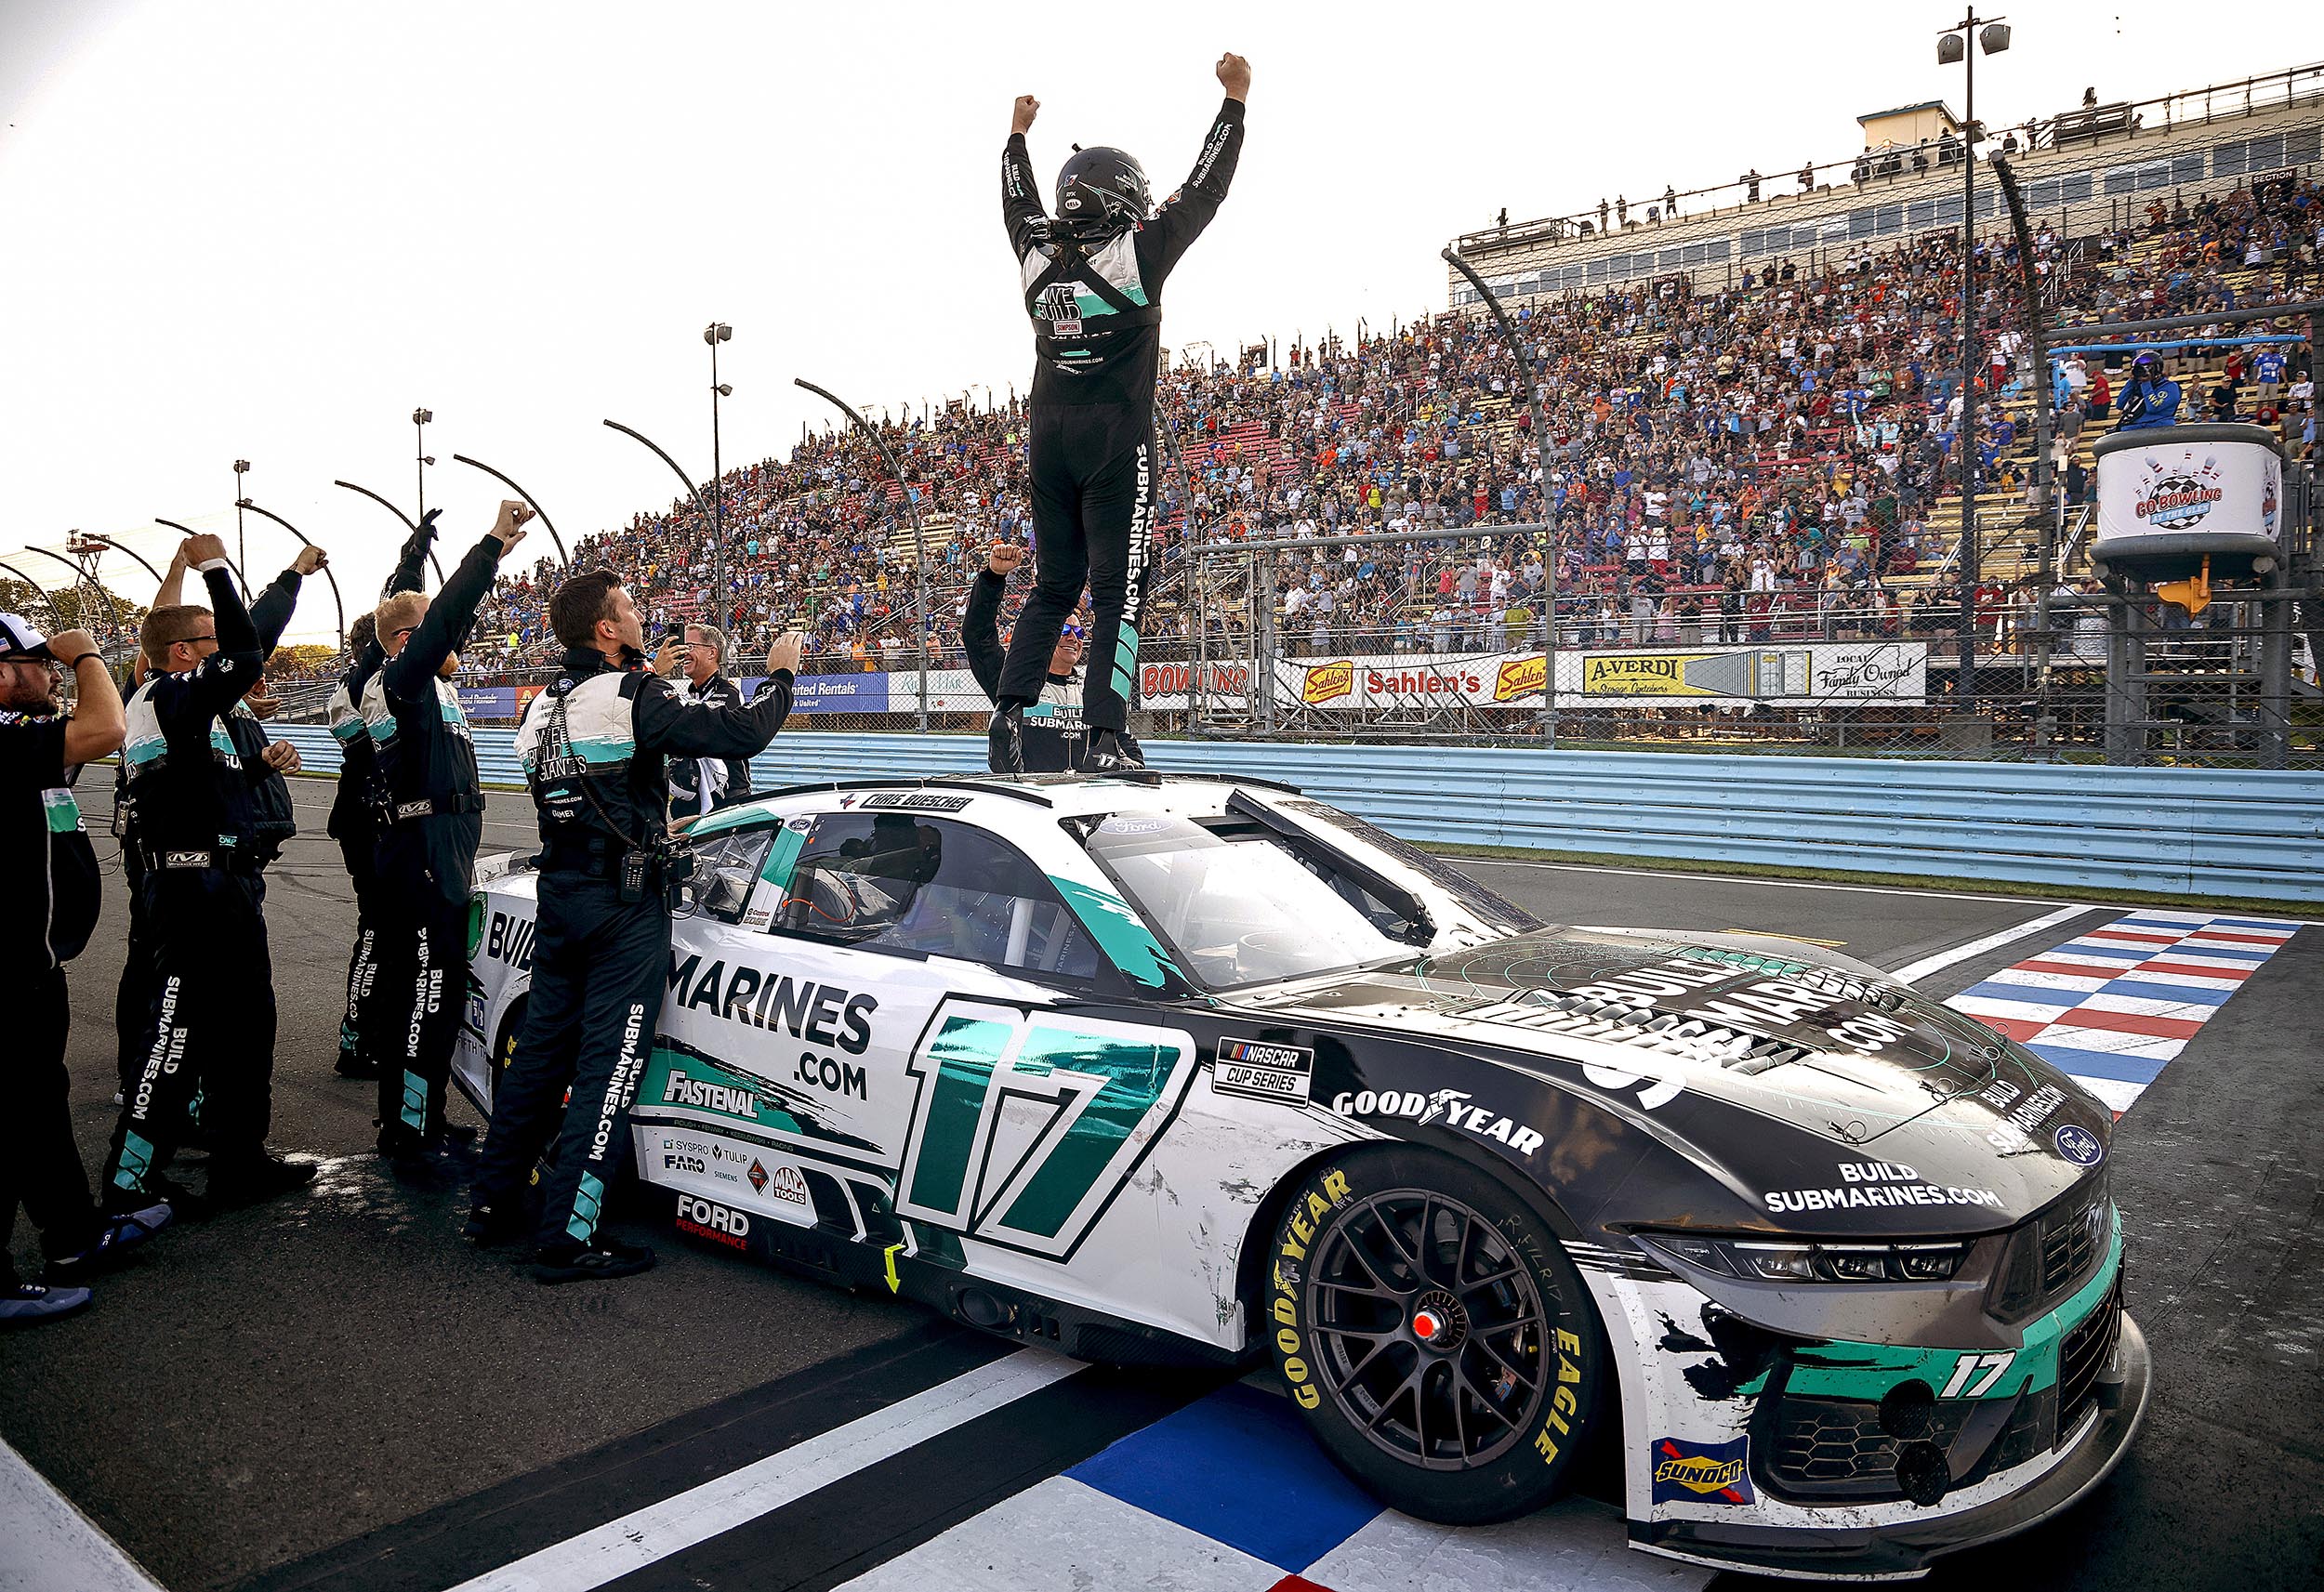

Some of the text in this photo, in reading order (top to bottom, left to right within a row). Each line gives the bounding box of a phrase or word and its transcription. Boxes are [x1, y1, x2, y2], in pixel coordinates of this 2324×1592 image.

[2253, 170, 2293, 184] SECTION
[1066, 200, 1080, 209] BELL
[1923, 227, 1956, 239] SECTION
[1045, 286, 1075, 305] WE
[1037, 302, 1081, 321] BUILD
[1056, 322, 1079, 332] SIMPSON
[2135, 488, 2223, 519] GO BOWLING
[1121, 443, 1149, 622] SUBMARINES.COM
[1591, 659, 1678, 682] A-VERDI
[1837, 654, 1868, 664] LOCAL
[1307, 669, 1350, 694] Sahlen's
[1367, 671, 1481, 694] Sahlen's
[1817, 658, 1912, 690] Family Owned
[792, 681, 857, 696] nited Rentals
[1029, 716, 1094, 730] SUBMARI
[1100, 753, 1116, 768] 17
[865, 793, 974, 811] CHRIS BUESCHER
[1114, 820, 1162, 833] Ford
[752, 909, 771, 917] Castrol
[487, 910, 536, 972] BUIL
[350, 929, 375, 1021] SUBMARINES.CO
[361, 963, 377, 997] BUILD
[428, 969, 443, 1013] BUILD
[667, 948, 879, 1056] MARINES
[132, 975, 181, 1120] SUBMARINES.COM
[164, 1027, 188, 1074] BUILD
[1246, 1046, 1300, 1068] NASCAR
[588, 1003, 644, 1162] SUBMARINES.COM
[793, 1051, 868, 1102] .COM
[1226, 1067, 1297, 1091] CUP SERIES
[663, 1069, 759, 1119] FASTENAL
[1978, 1079, 2022, 1110] BUILD
[673, 1119, 697, 1128] ROUSH
[701, 1124, 724, 1134] FENWAY
[771, 1140, 794, 1152] RACING
[895, 992, 1198, 1266] 17
[1332, 1088, 1546, 1157] GOODYEAR
[676, 1140, 708, 1155] SYSPRO
[723, 1150, 748, 1164] TULIP
[2059, 1129, 2097, 1162] Ford
[664, 1154, 706, 1175] FARO
[714, 1170, 738, 1182] SIEMENS
[1838, 1162, 1920, 1184] BUILD
[774, 1168, 805, 1194] MAC
[774, 1188, 805, 1204] TOOLS
[1765, 1183, 2003, 1214] SUBMARINES.COM
[677, 1194, 749, 1237] FORD
[676, 1217, 748, 1251] PERFORMANCE
[1940, 1350, 2016, 1401] 17
[1534, 1325, 1582, 1466] EAGLE
[1654, 1454, 1744, 1486] SUNOCO
